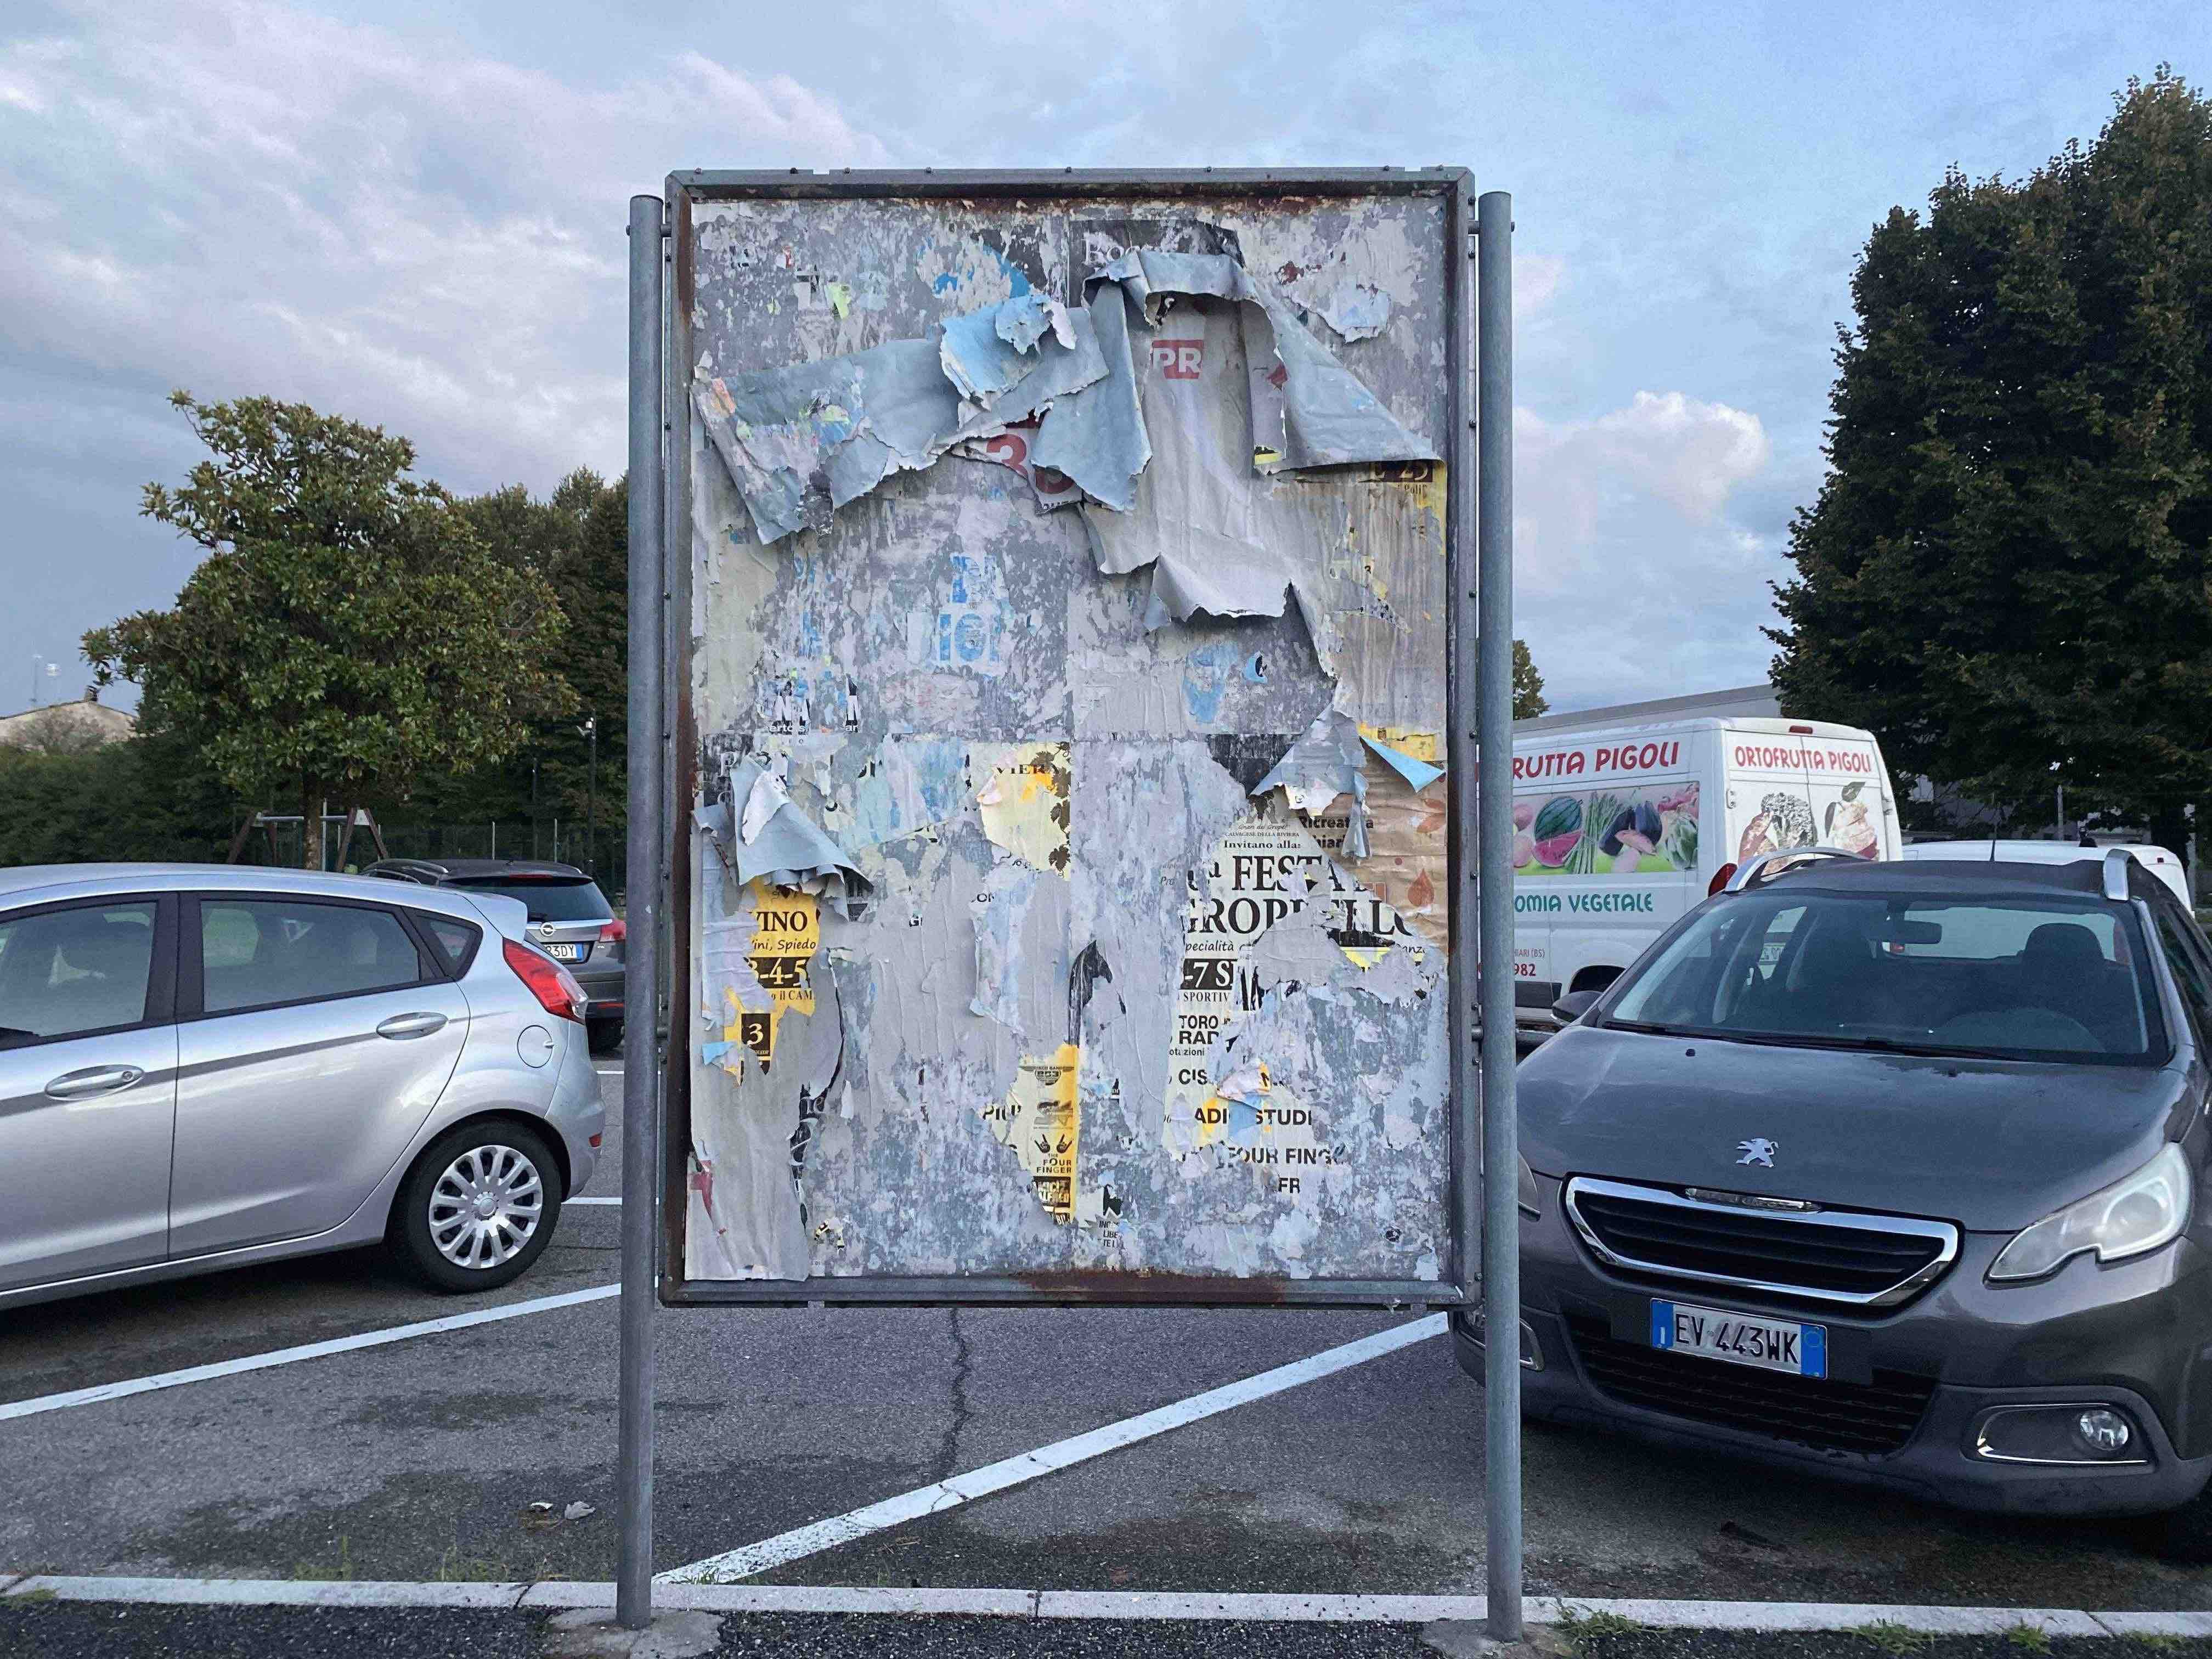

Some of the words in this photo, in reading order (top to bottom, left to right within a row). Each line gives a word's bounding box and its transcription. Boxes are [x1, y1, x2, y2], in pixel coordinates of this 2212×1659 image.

[1595, 741, 1679, 772] PIGOLI
[1735, 746, 1826, 770] ORTOFRUTTA
[1827, 751, 1872, 773] PIGOLI
[1224, 840, 1273, 848] Invitano
[1277, 840, 1301, 849] alla:
[1514, 894, 1562, 913] OMIA
[1568, 893, 1654, 913] VEGETALE
[777, 938, 817, 953] Spiedo
[1043, 1158, 1071, 1166] FOUR
[1675, 1313, 1705, 1346] EV
[1716, 1321, 1799, 1364] 443WK
